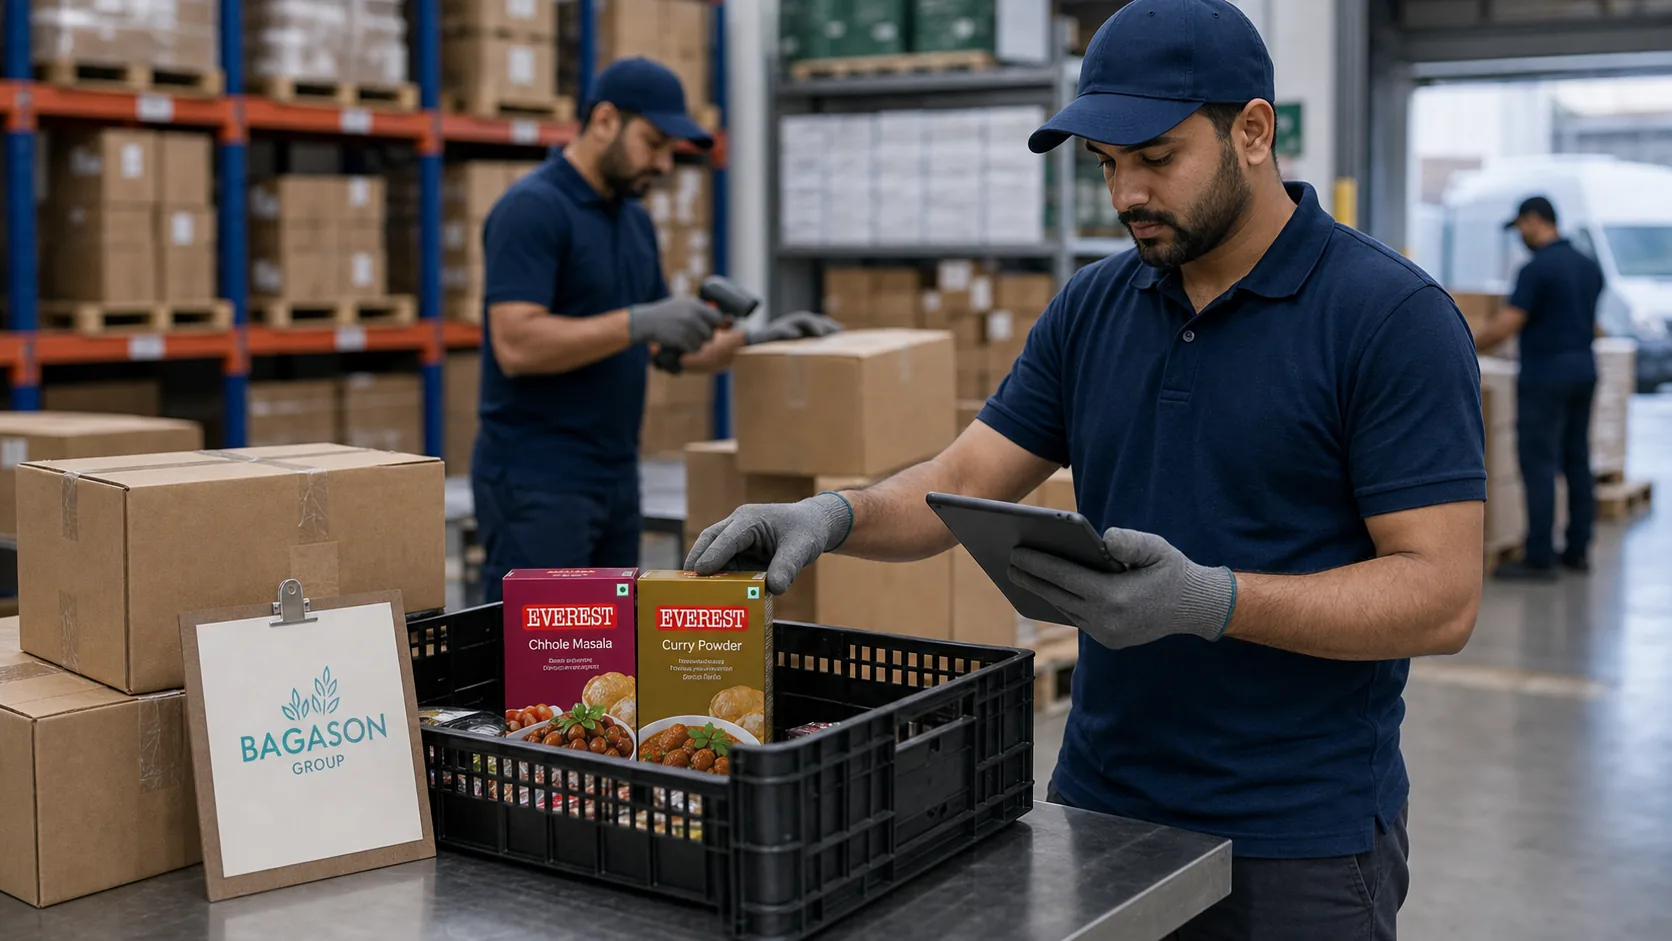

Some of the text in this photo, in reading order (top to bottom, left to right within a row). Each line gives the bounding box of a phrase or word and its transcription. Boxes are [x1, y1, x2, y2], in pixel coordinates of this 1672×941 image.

[526, 607, 613, 627] EVEREST
[659, 608, 745, 628] EVEREST
[528, 638, 612, 650] Chhole Masala
[662, 639, 742, 653] Curry Powder
[240, 713, 388, 763] BAGASON
[292, 754, 344, 775] GROUP
